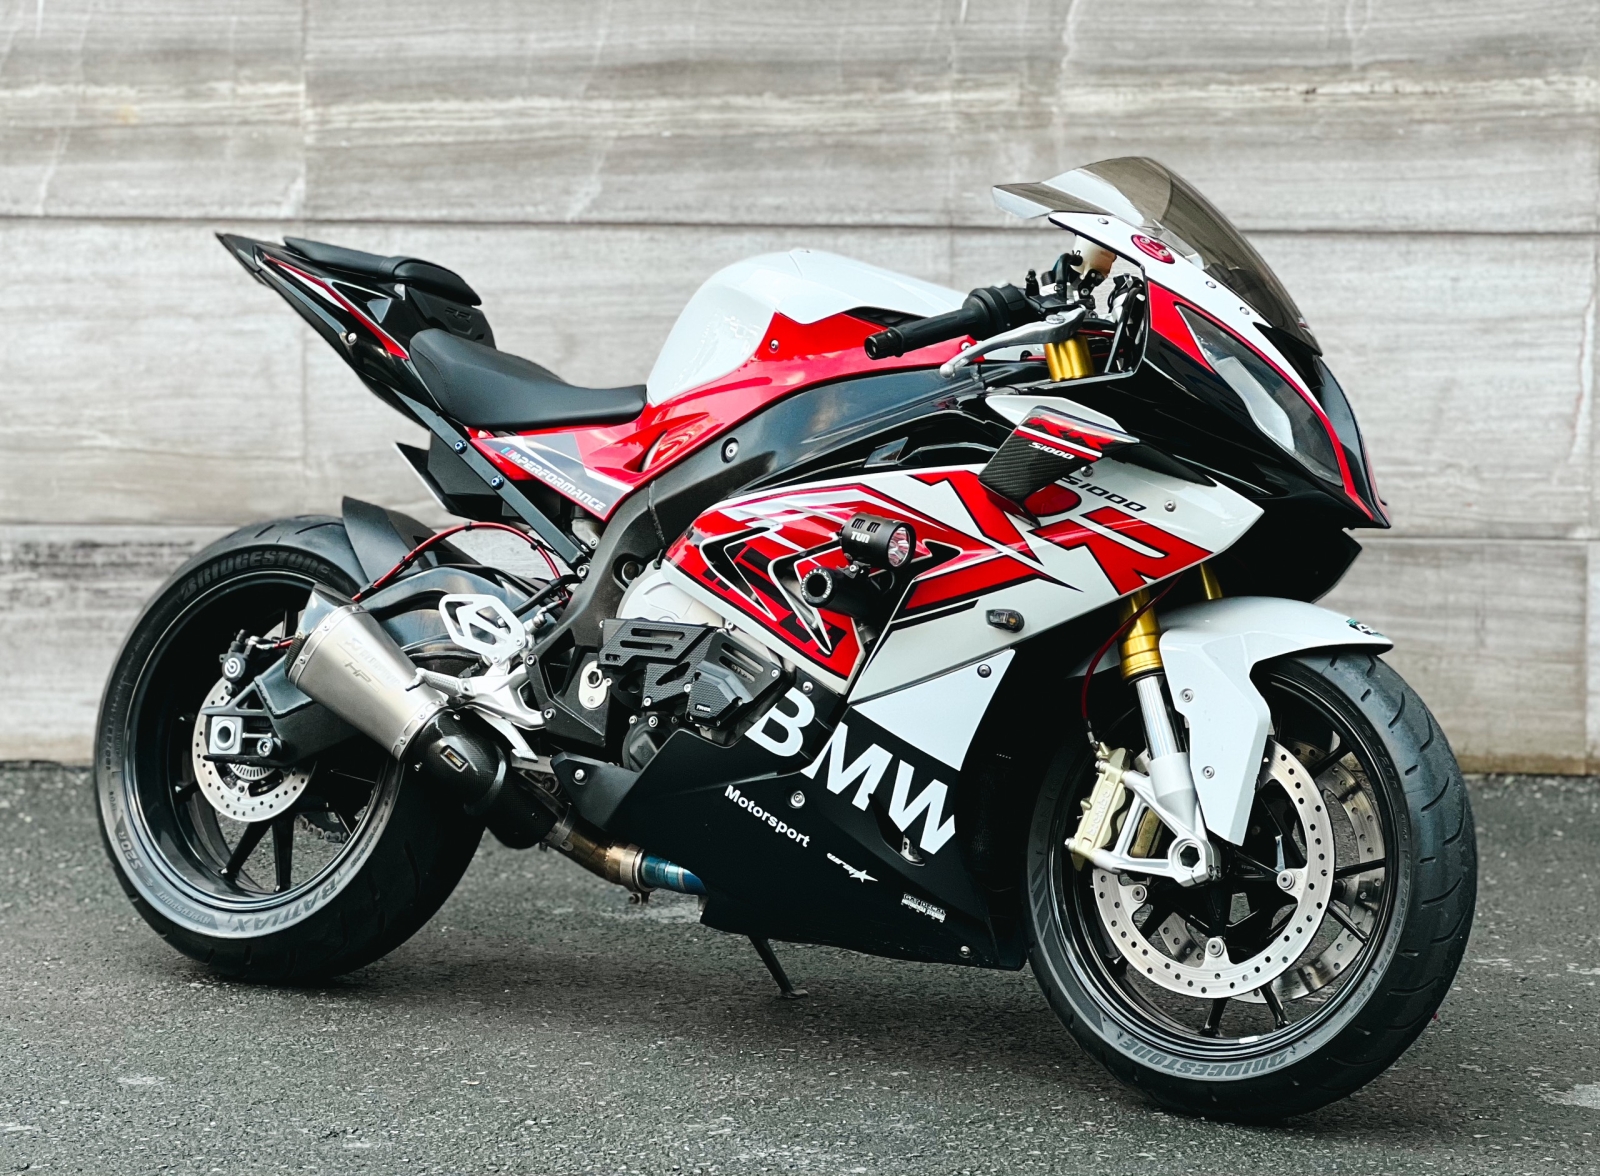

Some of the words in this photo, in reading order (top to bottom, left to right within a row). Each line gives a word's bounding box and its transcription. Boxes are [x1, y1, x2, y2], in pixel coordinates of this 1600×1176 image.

[1028, 441, 1075, 460] S1000
[1056, 474, 1147, 513] S1000
[180, 550, 331, 600] BRIDGESTONE
[744, 686, 956, 855] BMW
[724, 784, 810, 848] Motorsport
[157, 890, 212, 924] HYPERSPORT
[1119, 1037, 1288, 1077] BRIDGESTONE
